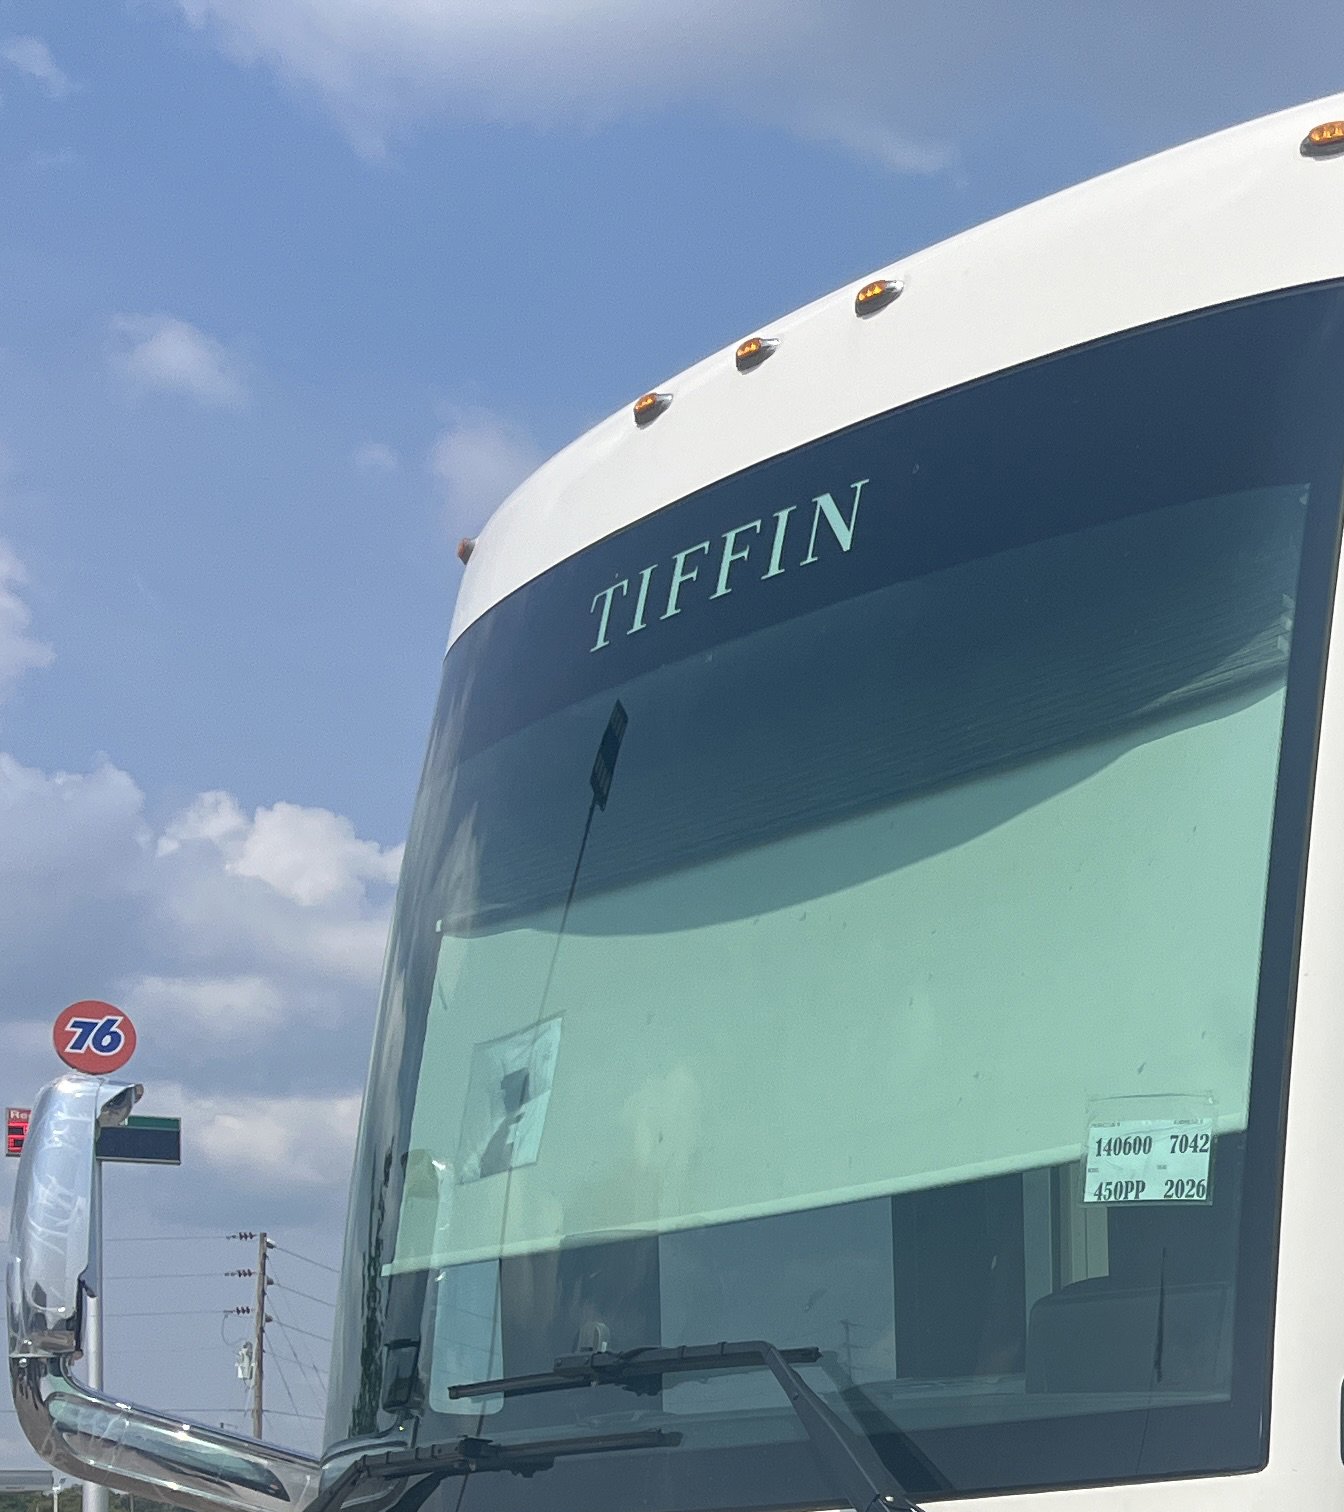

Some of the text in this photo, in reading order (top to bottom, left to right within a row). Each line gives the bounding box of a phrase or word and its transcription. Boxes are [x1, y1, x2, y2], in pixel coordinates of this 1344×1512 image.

[590, 479, 870, 653] TIFFIN
[65, 1016, 124, 1056] 76
[1096, 1134, 1210, 1157] 140600 7042
[1094, 1179, 1206, 1201] 450PP 2026
